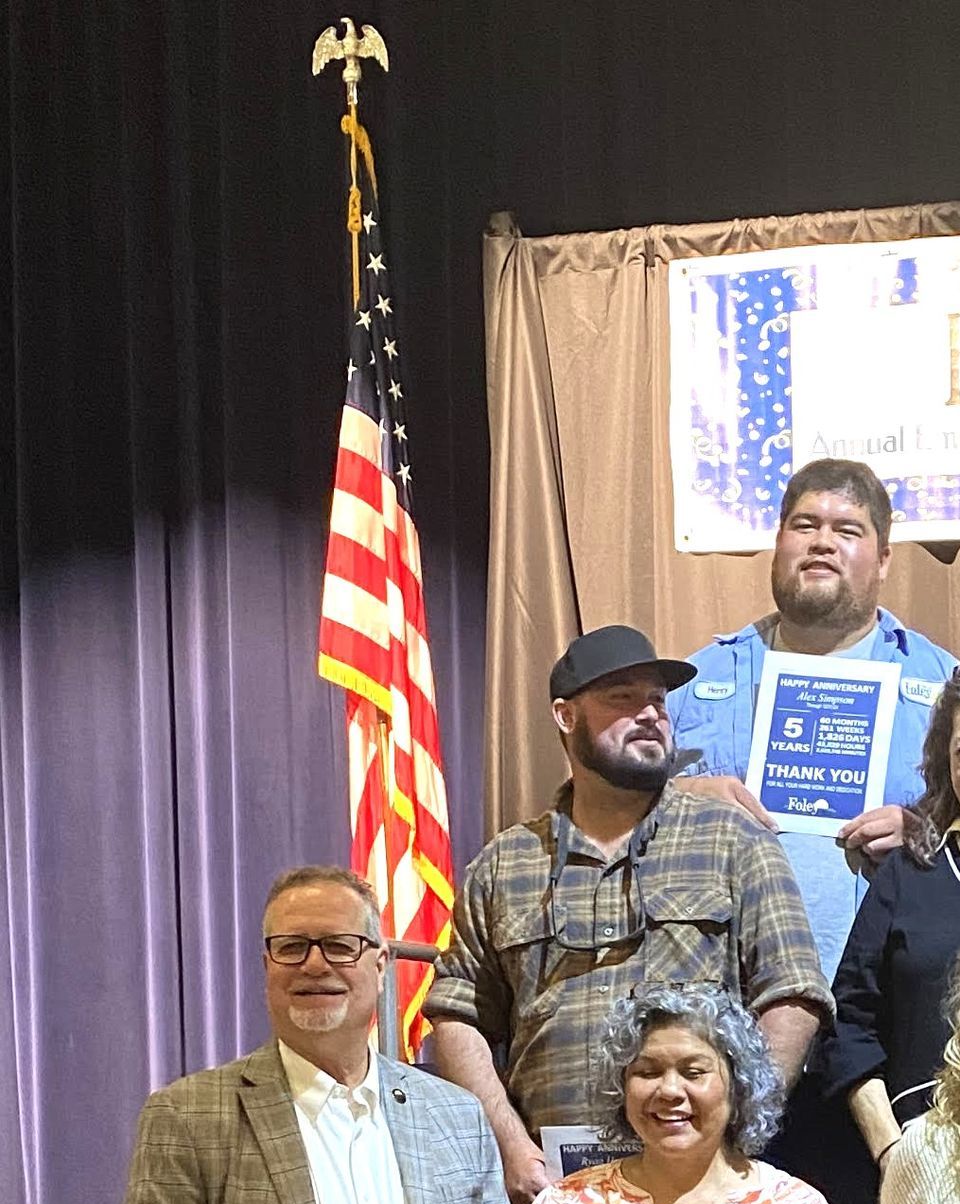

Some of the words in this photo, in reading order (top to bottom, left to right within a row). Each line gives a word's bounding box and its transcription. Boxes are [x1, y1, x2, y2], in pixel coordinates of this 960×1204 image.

[779, 678, 809, 688] HAPPY
[812, 681, 875, 694] ANNIVERSARY
[782, 717, 804, 738] 5
[831, 718, 868, 727] MONTHS
[836, 726, 864, 734] WEEKS
[817, 731, 844, 741] 1,826
[845, 734, 870, 744] DAYS
[770, 741, 810, 752] YEARS
[840, 742, 865, 750] HOURS
[765, 762, 826, 781] THANK
[828, 768, 865, 785] YOU
[786, 796, 818, 814] Foley
[562, 1144, 594, 1153] HAPPY
